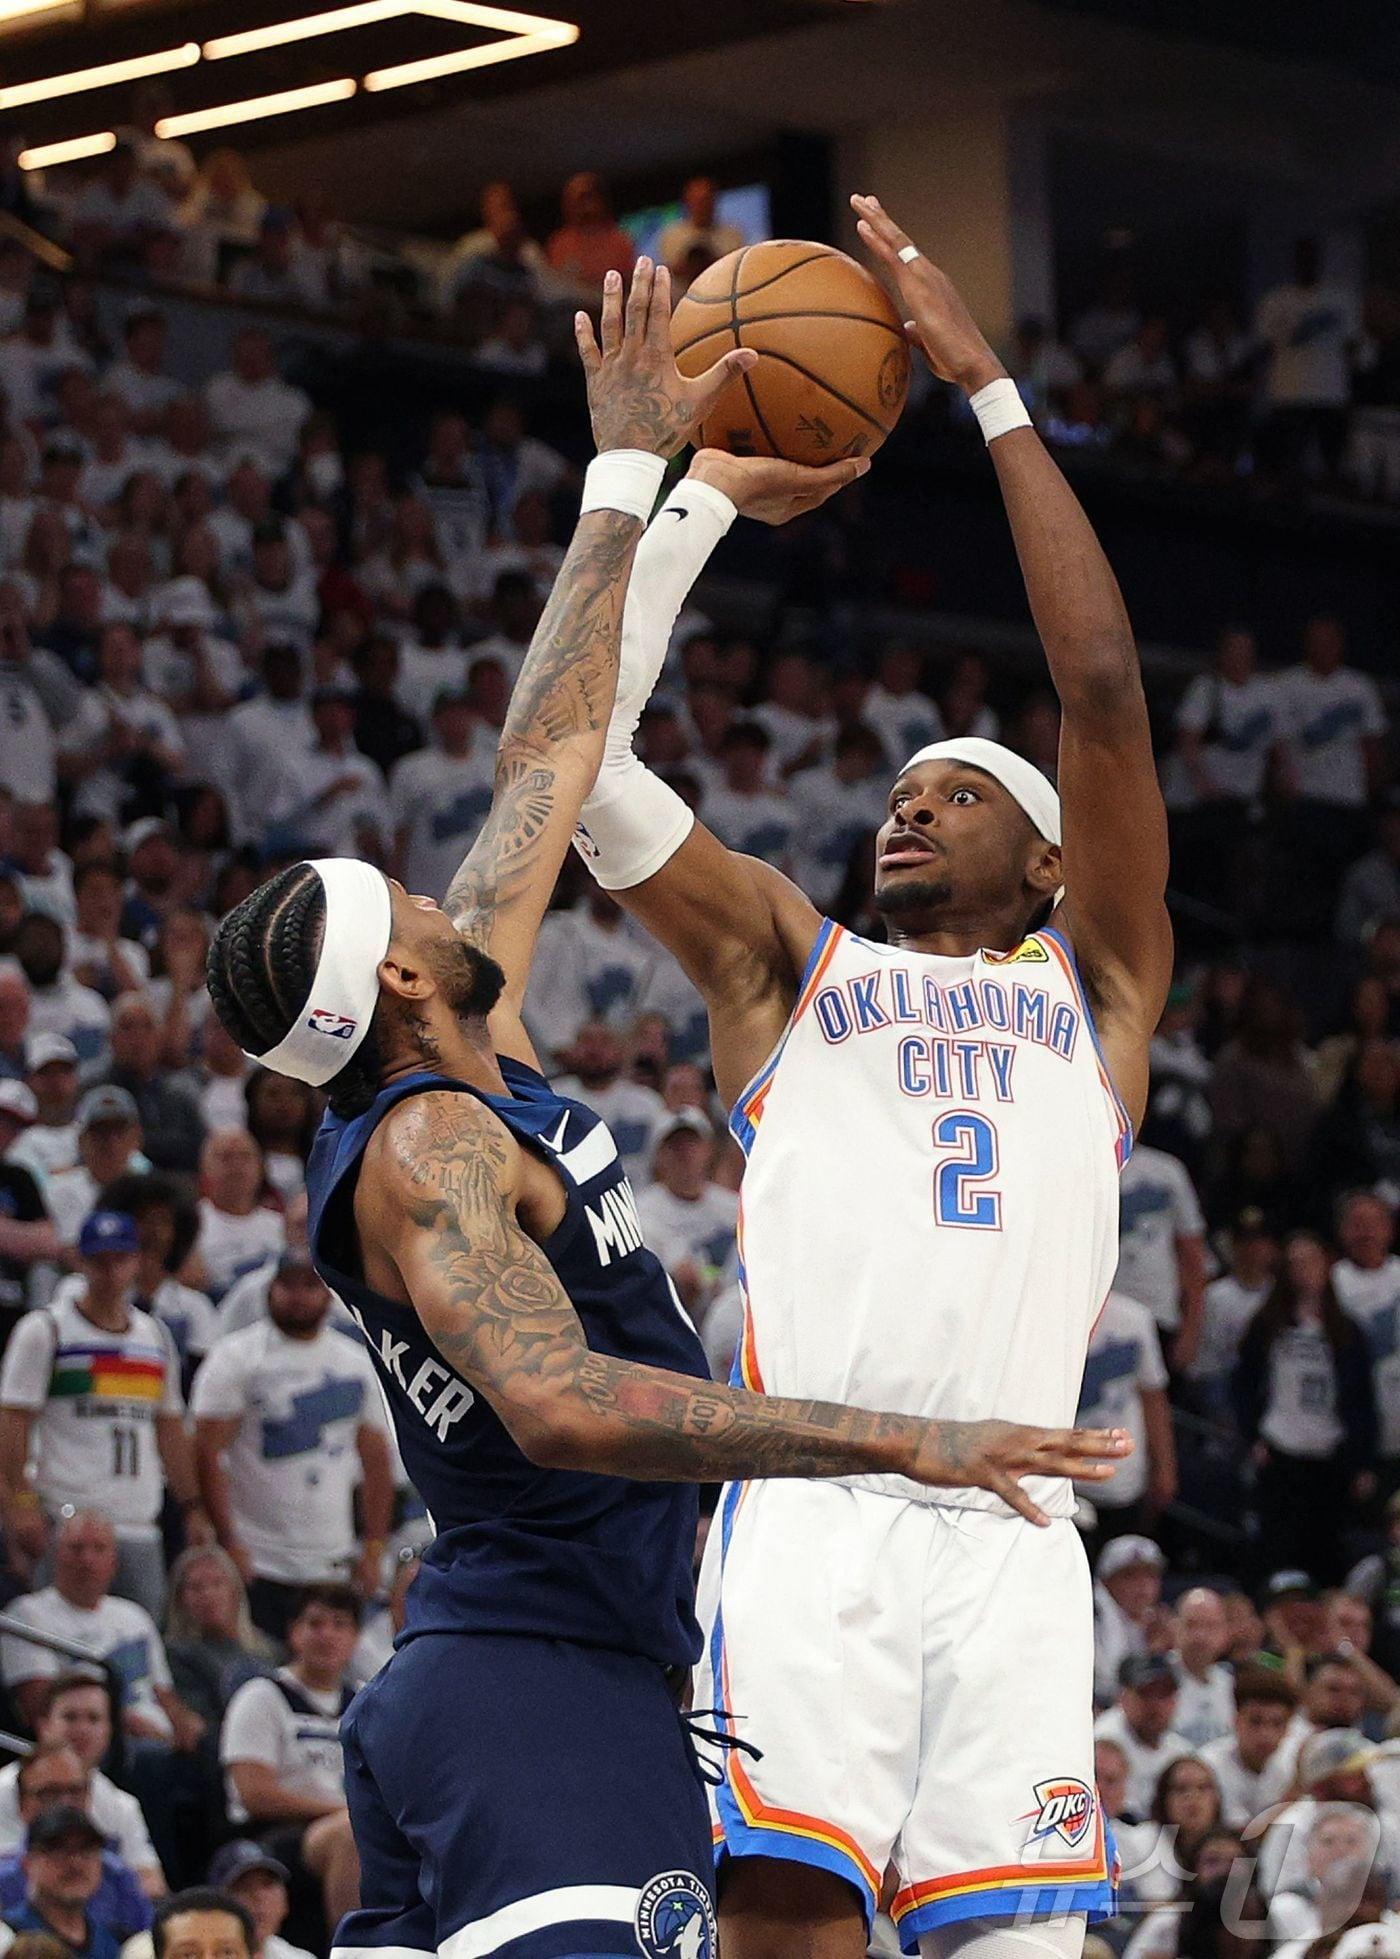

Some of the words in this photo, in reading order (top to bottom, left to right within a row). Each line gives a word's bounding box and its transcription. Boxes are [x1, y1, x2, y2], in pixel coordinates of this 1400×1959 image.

[815, 969, 1079, 1062] OKLAHOMA
[898, 1036, 1016, 1102] CITY
[932, 1109, 1003, 1232] 2
[351, 1304, 474, 1443] KER
[1036, 1793, 1086, 1831] OKC
[640, 1877, 685, 1939] MINNESOTA
